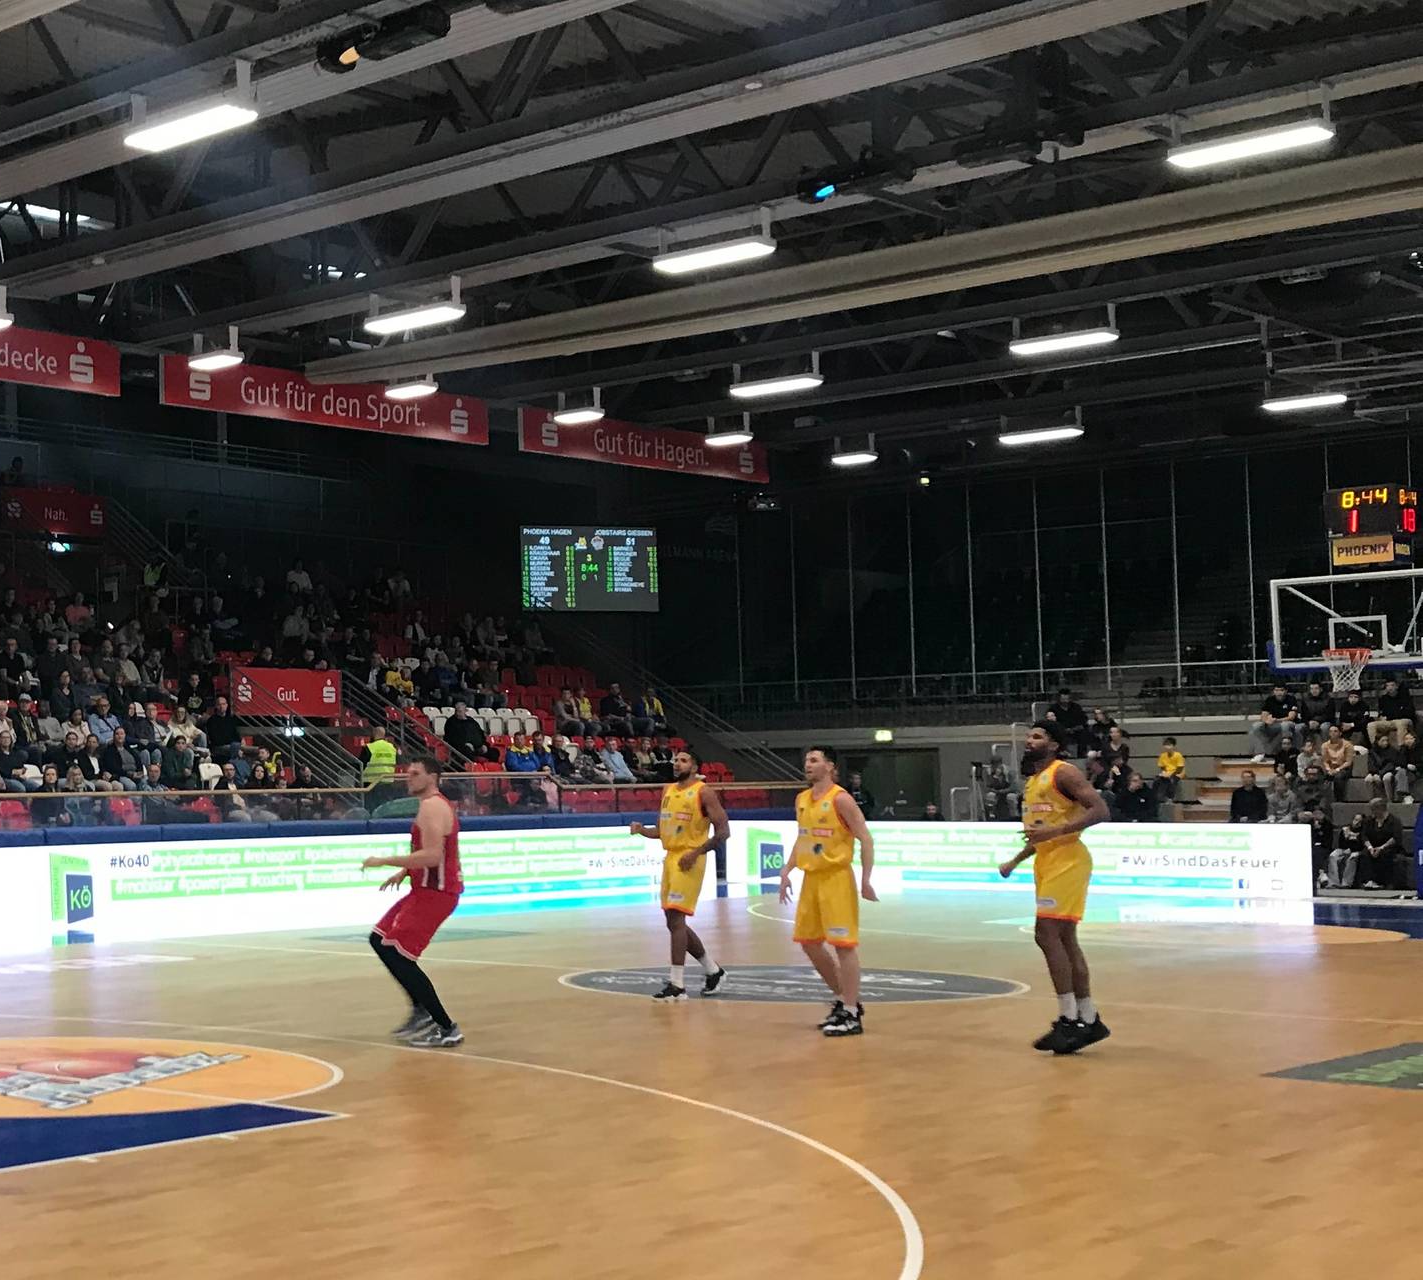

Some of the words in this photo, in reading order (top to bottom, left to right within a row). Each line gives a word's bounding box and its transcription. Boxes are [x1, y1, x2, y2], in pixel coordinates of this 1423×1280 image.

[240, 376, 280, 409] Gut
[284, 381, 317, 414] für
[321, 388, 361, 418] den
[366, 397, 427, 429] Sport.
[593, 429, 624, 454] Gut
[627, 431, 652, 459] für
[654, 438, 709, 469] Hagen.
[1342, 487, 1389, 509] 8:44
[1350, 508, 1359, 533] 1
[1336, 542, 1390, 558] PHOENIX
[277, 686, 300, 702] Gut.
